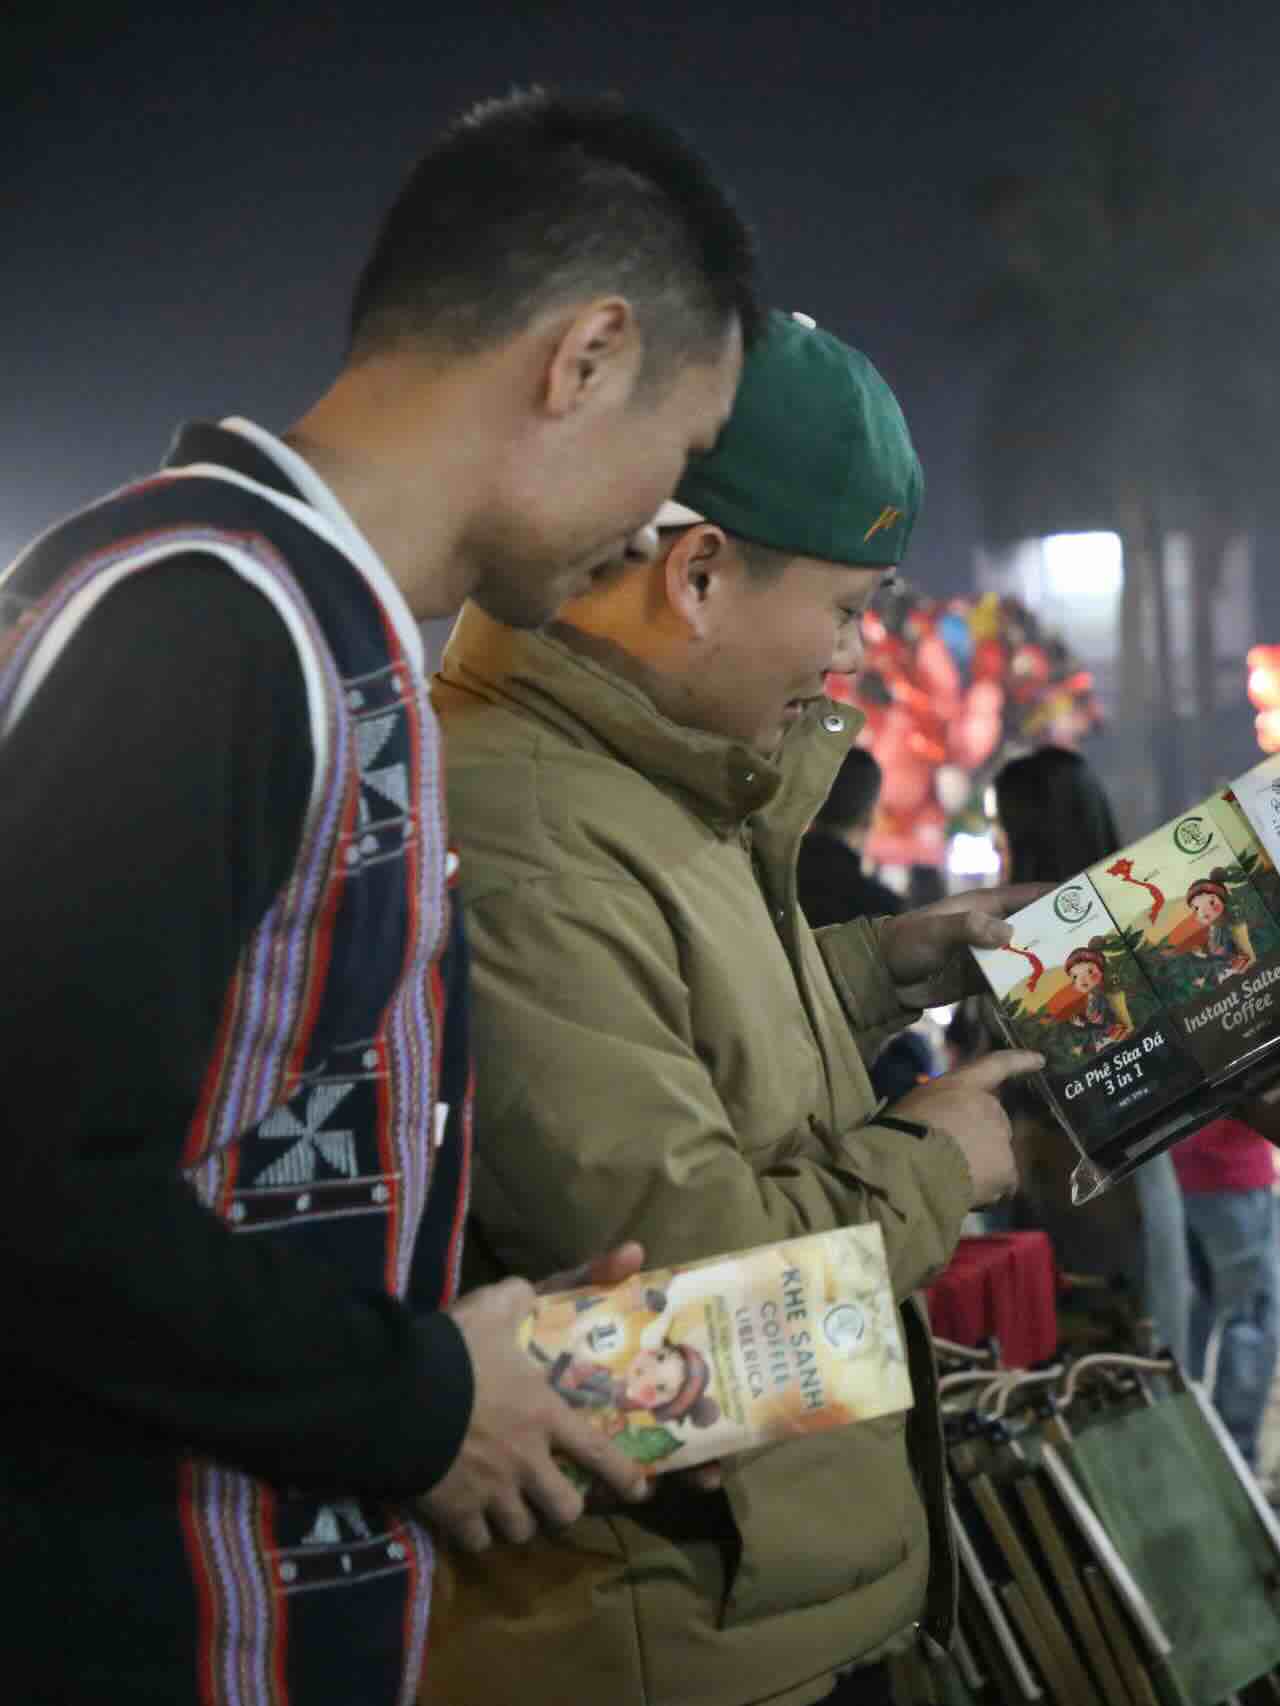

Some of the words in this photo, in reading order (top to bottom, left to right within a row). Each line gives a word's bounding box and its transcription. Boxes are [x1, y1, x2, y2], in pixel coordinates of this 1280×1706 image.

[1183, 991, 1240, 1033] Instant
[1221, 993, 1272, 1030] Coffee
[1064, 1080, 1085, 1100] Cà
[1085, 1062, 1112, 1087] Phê
[1142, 1032, 1165, 1052] Đá
[1104, 1079, 1115, 1095] 3
[1116, 1073, 1133, 1088] in
[1133, 1063, 1143, 1077] 1
[782, 1268, 807, 1322] KHE
[791, 1330, 825, 1408] SANH
